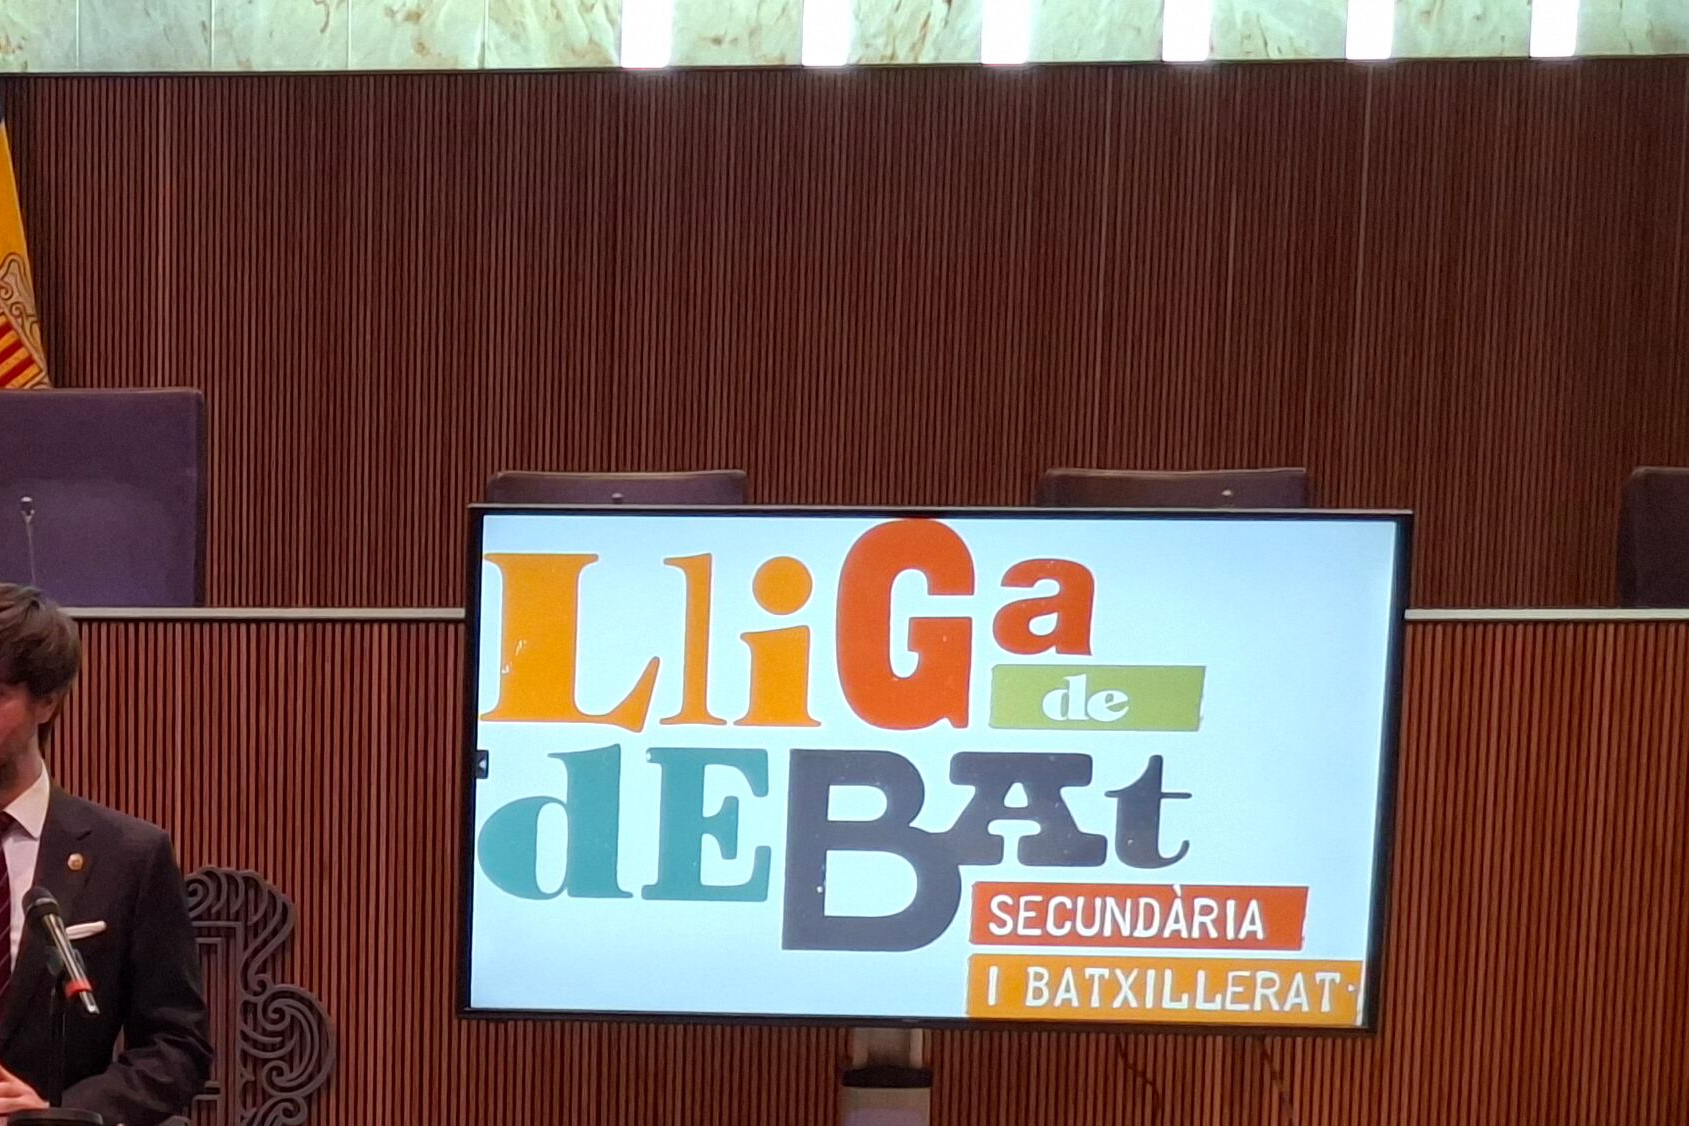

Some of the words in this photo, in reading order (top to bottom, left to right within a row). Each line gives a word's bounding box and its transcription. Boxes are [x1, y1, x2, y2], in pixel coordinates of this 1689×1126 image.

[1041, 673, 1130, 724] de
[987, 887, 1265, 941] SECUNDÀRIA
[988, 965, 999, 1006] I
[1024, 965, 1340, 1015] BATXILLERAT
